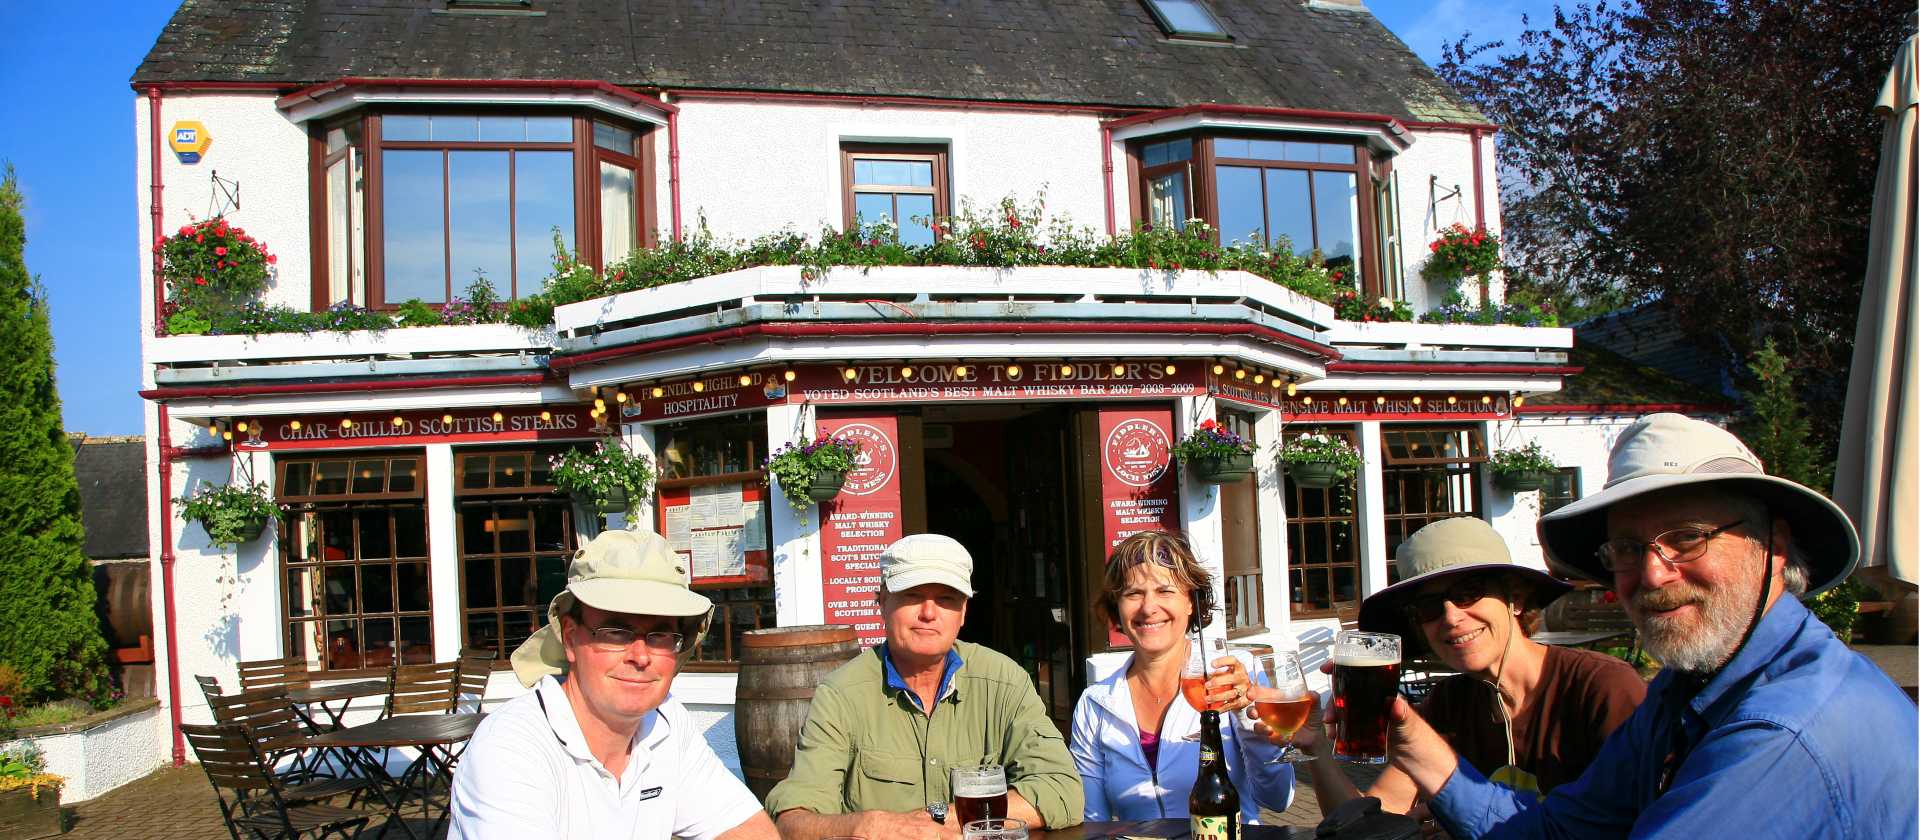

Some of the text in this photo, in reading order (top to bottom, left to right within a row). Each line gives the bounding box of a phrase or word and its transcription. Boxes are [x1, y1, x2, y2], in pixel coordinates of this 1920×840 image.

[176, 131, 196, 141] ADT
[836, 363, 1164, 384] WELCOME TO FIDDLER'S
[641, 373, 763, 401] FRENDLY HIGHLD
[803, 388, 850, 400] VOTED
[854, 386, 940, 399] SCOTLAND'S
[943, 386, 978, 397] BEST
[983, 385, 1017, 397] MALT
[1023, 384, 1076, 396] WHISKY
[1080, 384, 1106, 395] BAR
[663, 393, 739, 415] HOSPITALITY
[1334, 400, 1368, 414] MALT
[1372, 399, 1422, 413] WHISKY
[1427, 399, 1494, 413] SELECTION
[279, 412, 578, 441] CHAR-GRILLED SCOTTISH STEAKS
[1112, 424, 1164, 447] FIDDLER'S
[863, 471, 886, 489] NESS
[1116, 465, 1140, 482] LOCH
[829, 512, 894, 521] AWARD-WINNING
[1115, 507, 1165, 516] MALT WHISKY
[1120, 516, 1160, 524] SELECTION
[840, 530, 885, 538] SELECTION
[829, 577, 863, 585] LOCALLY
[828, 601, 849, 609] OVER
[849, 600, 859, 608] 30
[834, 609, 874, 617] SCOTTISH
